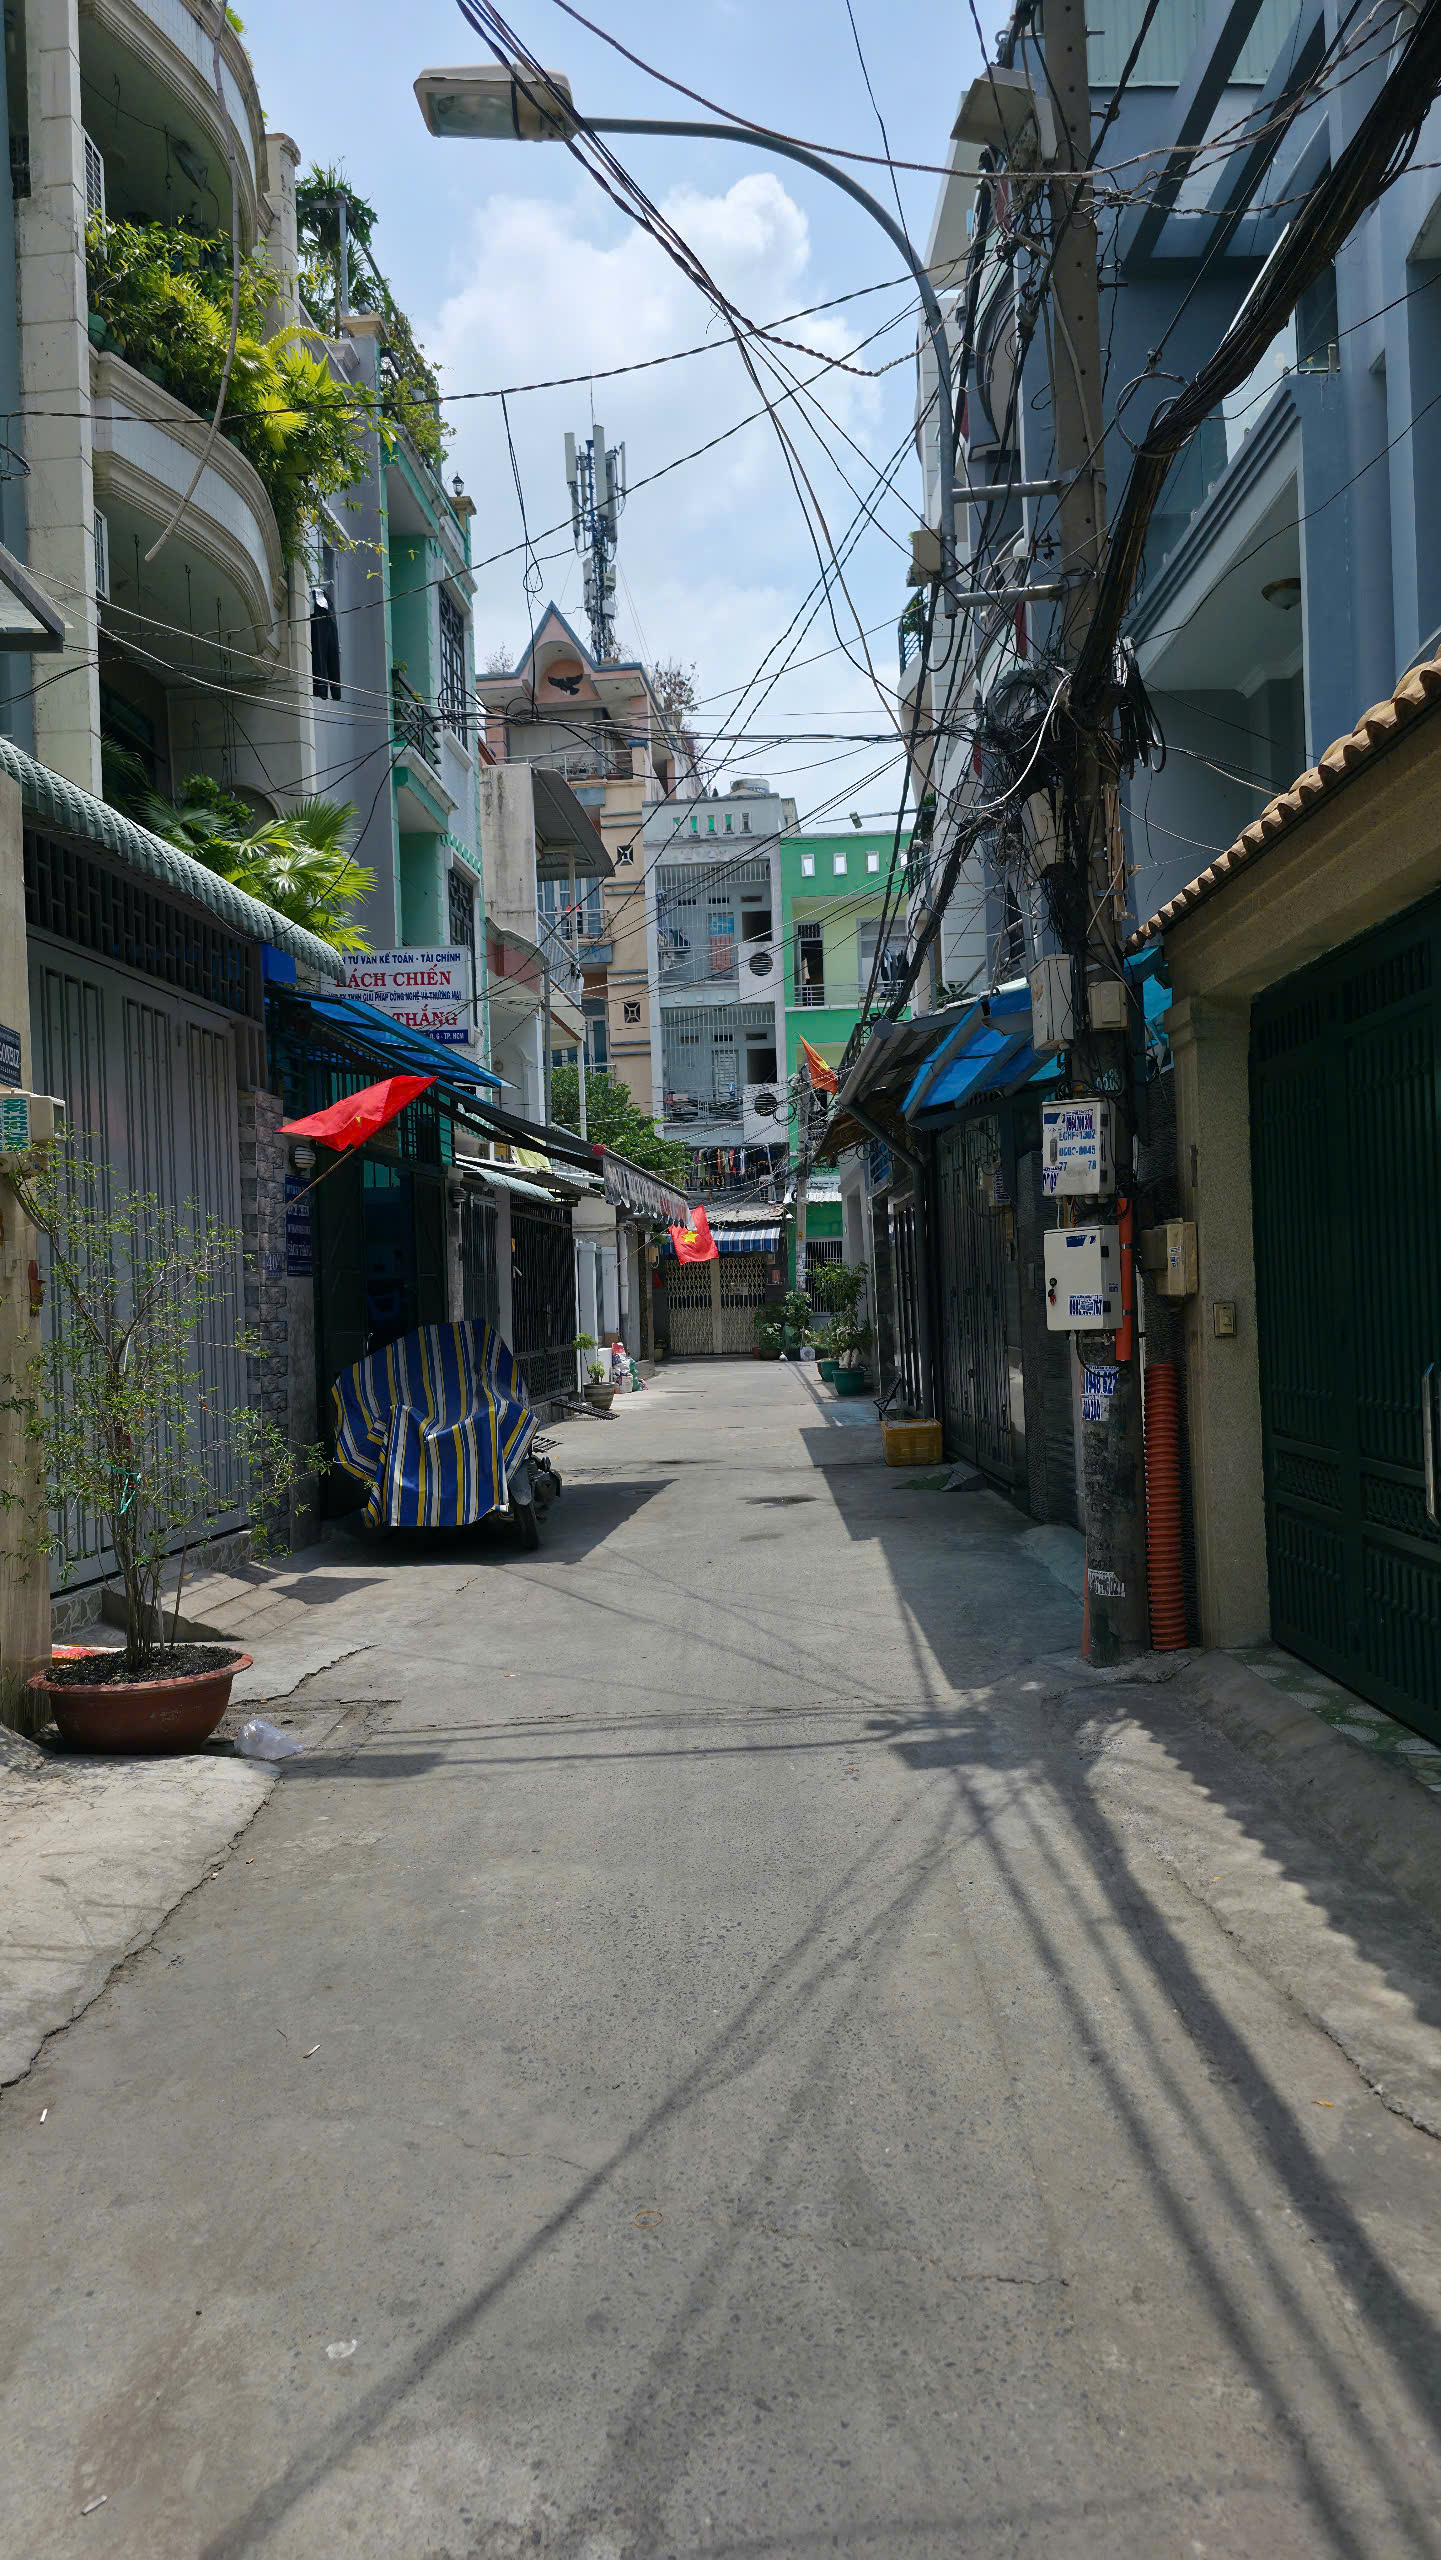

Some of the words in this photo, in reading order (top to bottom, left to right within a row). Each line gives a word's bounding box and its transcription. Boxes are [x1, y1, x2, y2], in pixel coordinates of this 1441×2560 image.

[379, 951, 391, 964] KẾ
[392, 951, 414, 964] TOÁN
[420, 951, 434, 963] TÀI
[435, 950, 461, 963] CHÍNH
[393, 964, 452, 987] CHIẾN
[392, 1004, 458, 1027] THẮNG
